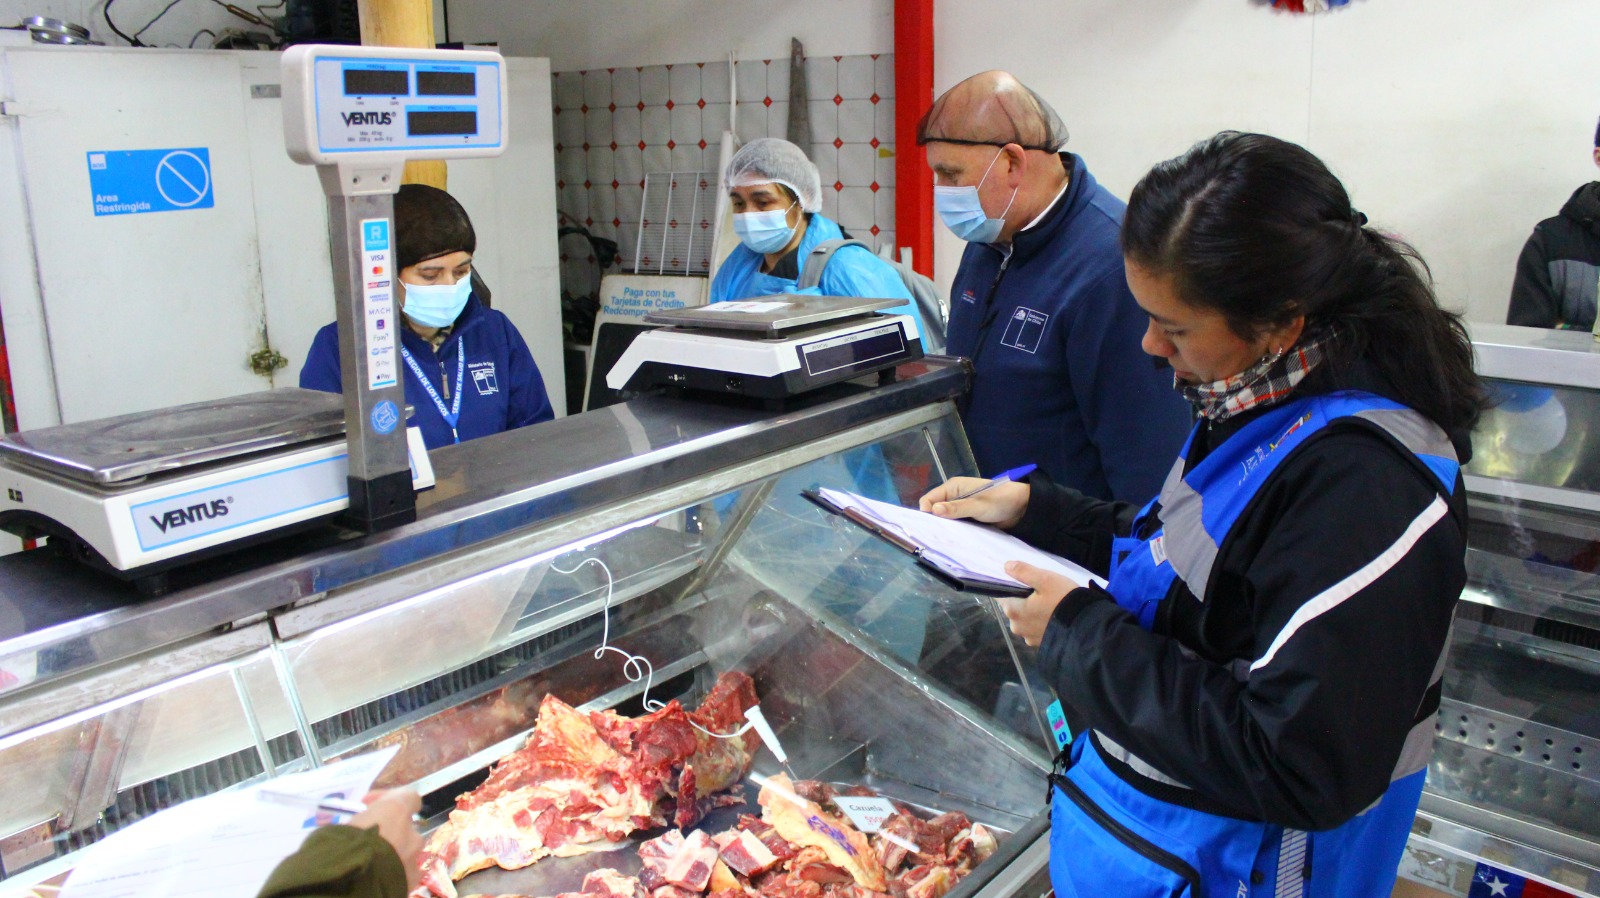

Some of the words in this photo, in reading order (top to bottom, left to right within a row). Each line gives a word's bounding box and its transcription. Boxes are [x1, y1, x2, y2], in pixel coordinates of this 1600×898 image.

[96, 194, 118, 203] Area
[96, 202, 151, 213] Restringida
[624, 287, 644, 298] Paga
[645, 289, 660, 298] con
[662, 289, 676, 298] tus
[611, 296, 641, 307] Tarjetas
[642, 298, 653, 307] de
[369, 307, 391, 315] MACH
[406, 356, 425, 378] REGION
[420, 377, 430, 387] DE
[426, 385, 437, 397] LOS
[434, 397, 449, 417] LAGOS
[150, 498, 229, 535] VENTUS
